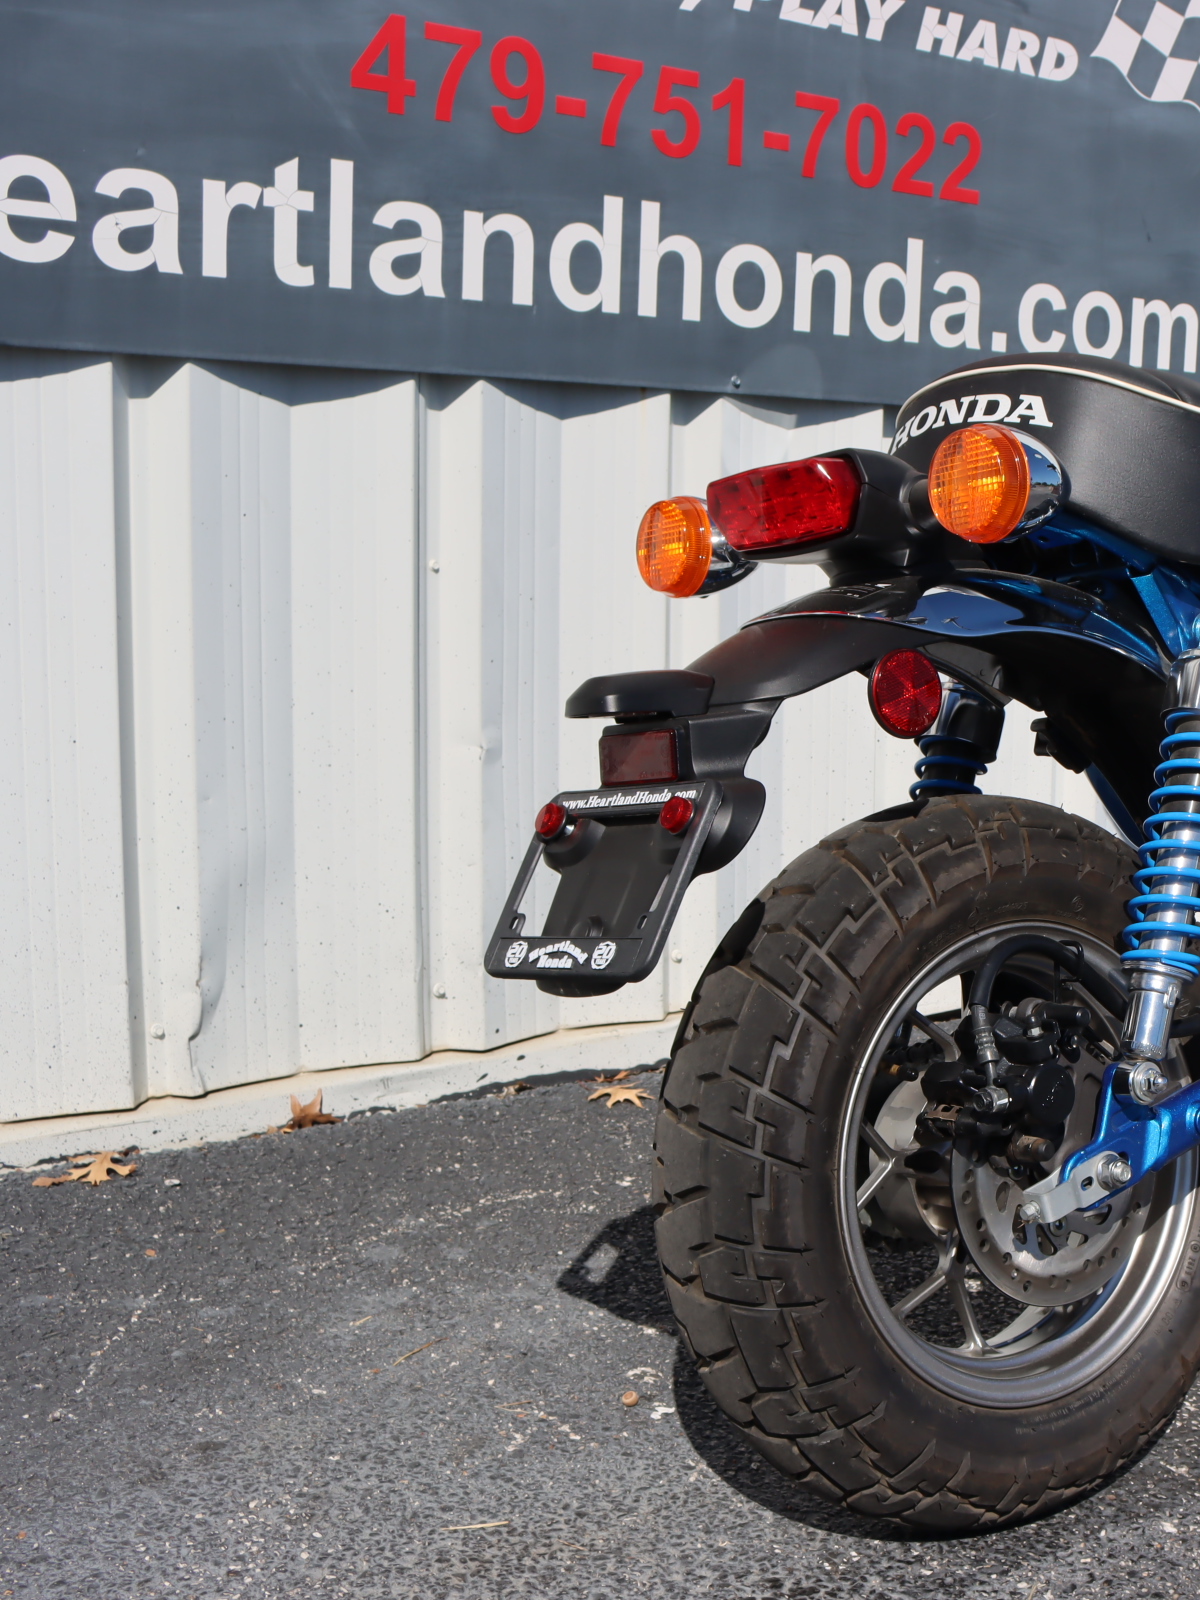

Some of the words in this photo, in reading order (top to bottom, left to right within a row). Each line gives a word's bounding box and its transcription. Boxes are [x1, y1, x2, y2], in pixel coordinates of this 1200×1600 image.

[733, 0, 907, 41] LAY
[915, 5, 1079, 82] HARD
[350, 13, 982, 205] 479-751-7022
[0, 153, 1199, 374] eartlandhonda.com
[889, 393, 1054, 456] HONDA
[562, 788, 697, 810] www.HeartlandHondacom
[528, 940, 589, 965] Heartland
[536, 954, 573, 969] Honda
